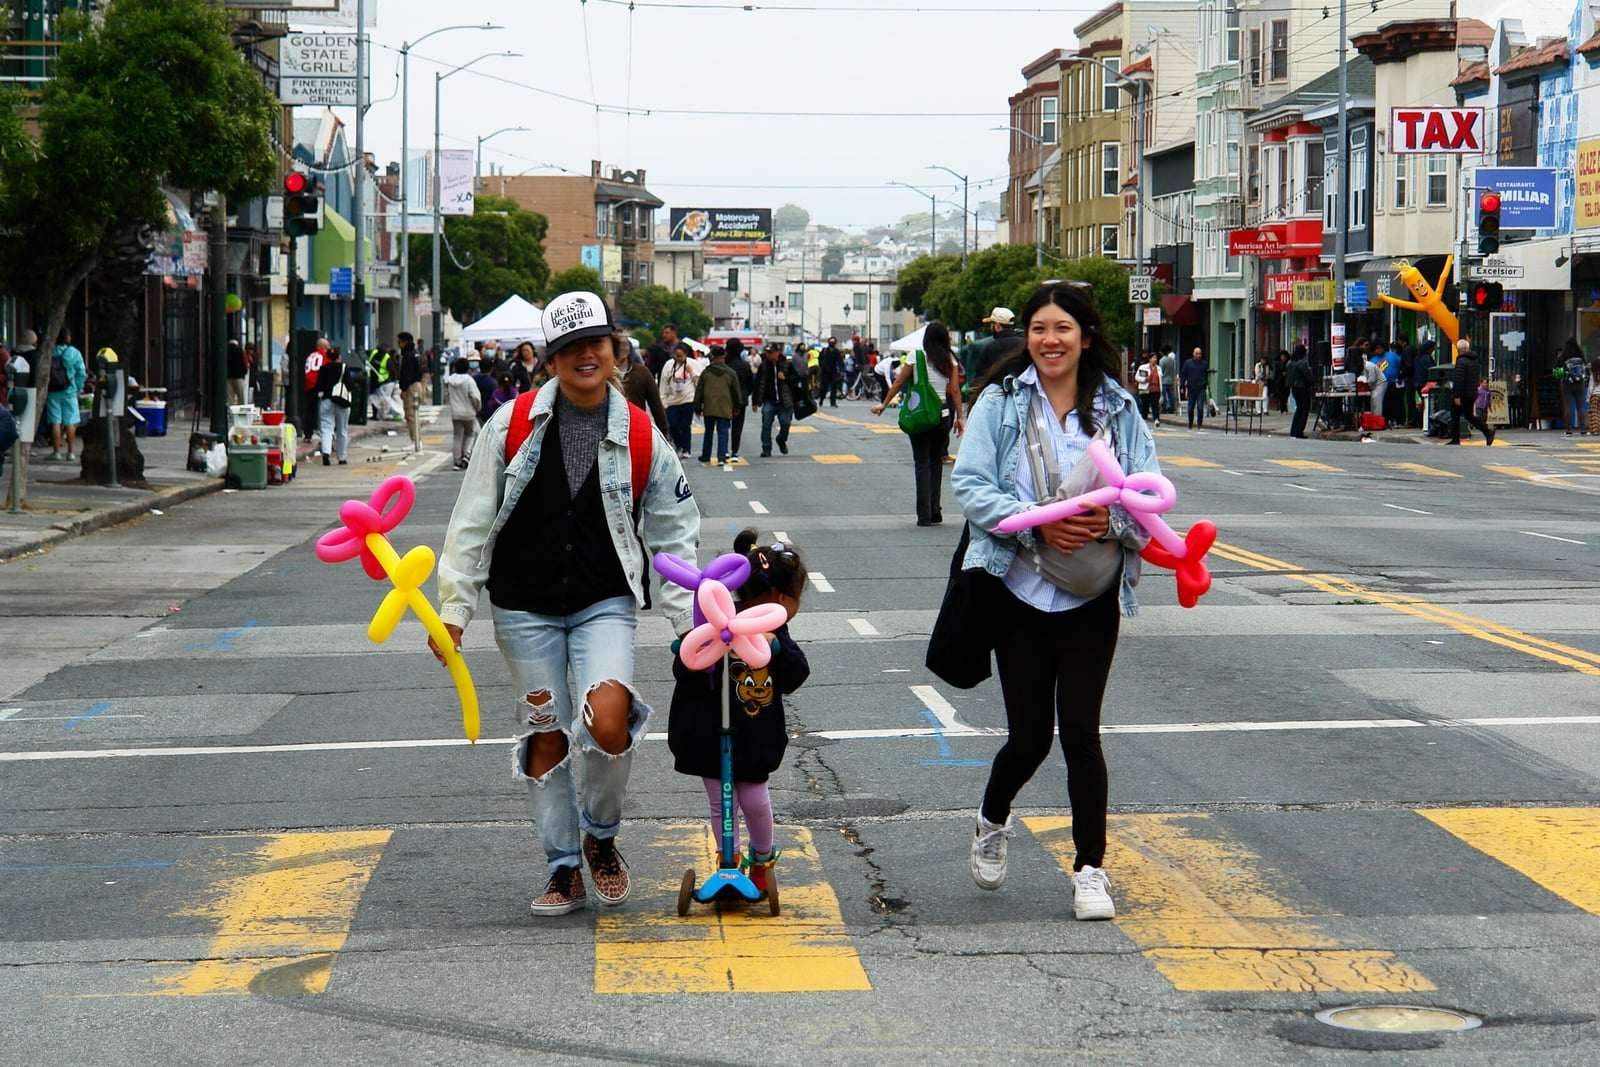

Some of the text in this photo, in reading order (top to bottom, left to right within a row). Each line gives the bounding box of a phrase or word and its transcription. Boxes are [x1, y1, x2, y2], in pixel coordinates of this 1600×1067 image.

[290, 36, 358, 47] GOLDEN
[300, 49, 349, 60] STATE
[300, 62, 349, 73] GRILL
[1398, 111, 1479, 149] TAX
[1500, 190, 1549, 205] MILIAR
[715, 213, 760, 223] Motorcycle
[717, 221, 759, 230] Accident?
[1233, 242, 1262, 250] American
[1476, 266, 1517, 275] Excelsior
[1131, 290, 1149, 300] 20
[551, 304, 575, 322] Life is
[551, 307, 594, 328] Beautiful
